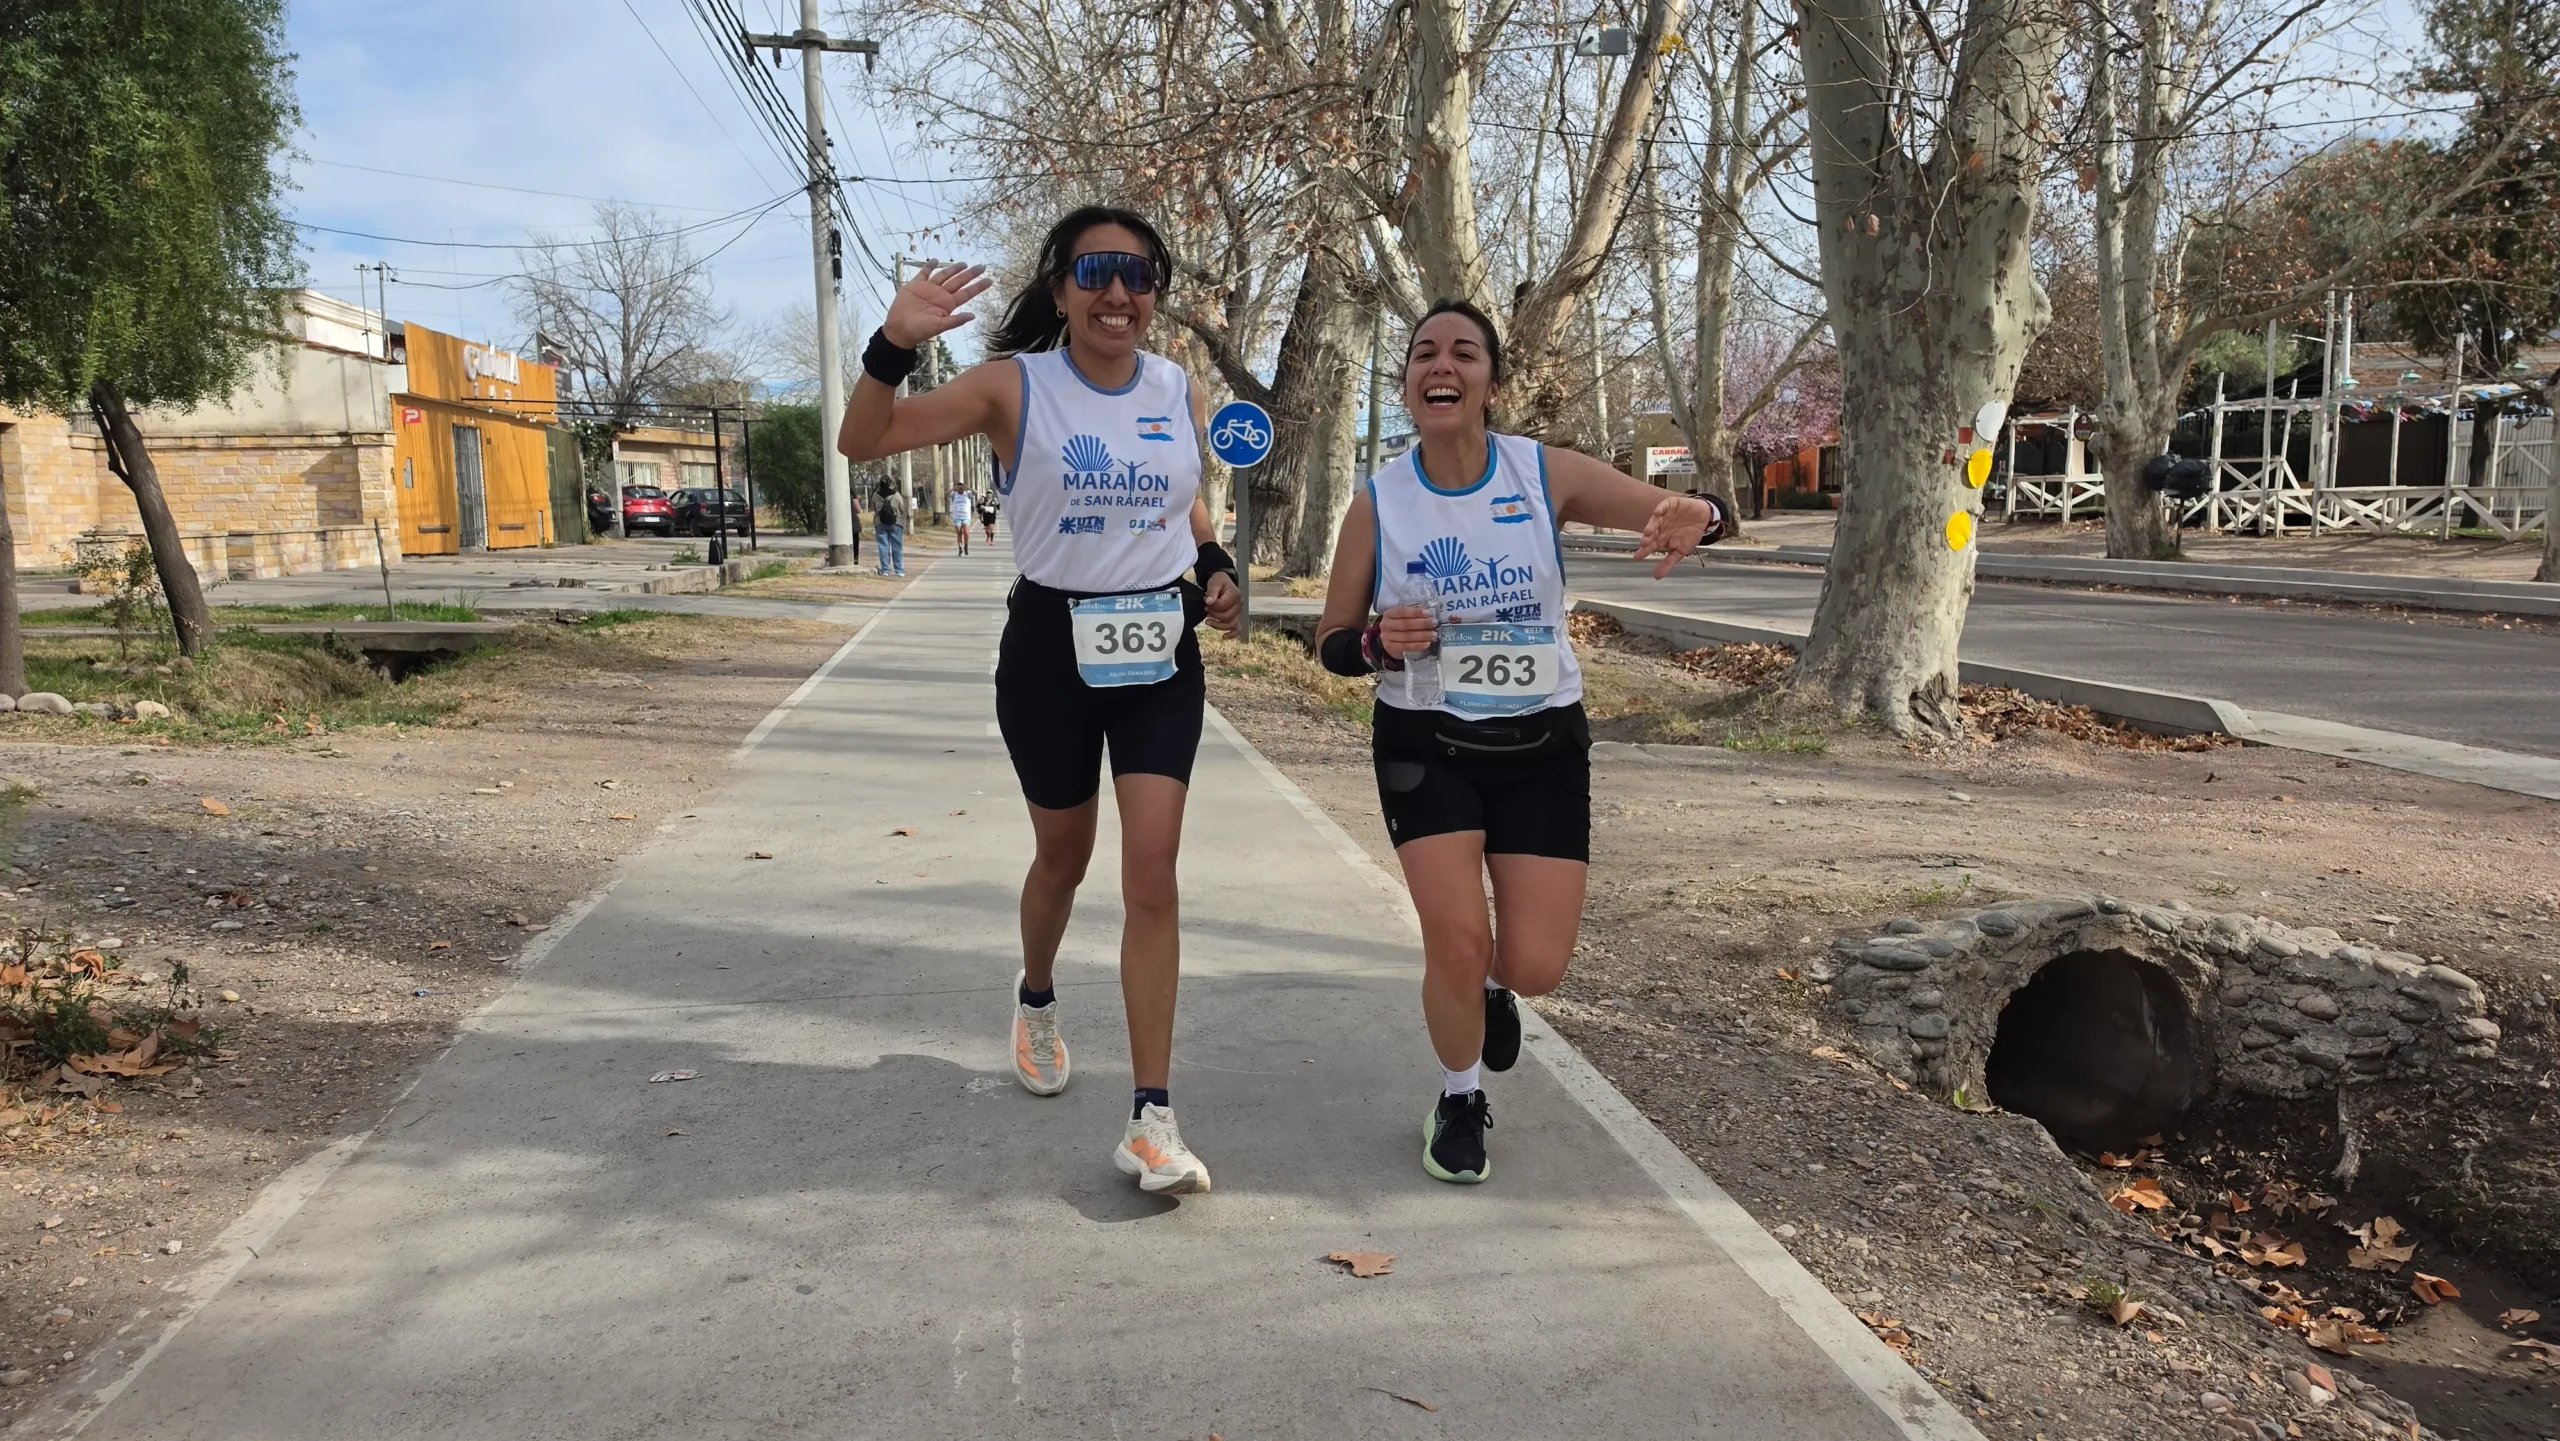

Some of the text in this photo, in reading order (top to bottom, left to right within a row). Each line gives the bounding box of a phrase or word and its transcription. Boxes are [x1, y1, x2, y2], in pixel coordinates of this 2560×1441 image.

[1063, 467, 1169, 494] MARATON
[1070, 495, 1166, 507] DE SAN RAFAEL
[1077, 515, 1105, 526] UTN
[1115, 597, 1145, 610] 21K
[1446, 597, 1477, 612] SAN
[1481, 588, 1534, 607] RAFAEL
[1514, 603, 1541, 615] UTN
[1095, 621, 1167, 655] 363
[1481, 629, 1514, 641] 21K
[1458, 654, 1536, 687] 263
[1460, 700, 1496, 708] FLORENCIA
